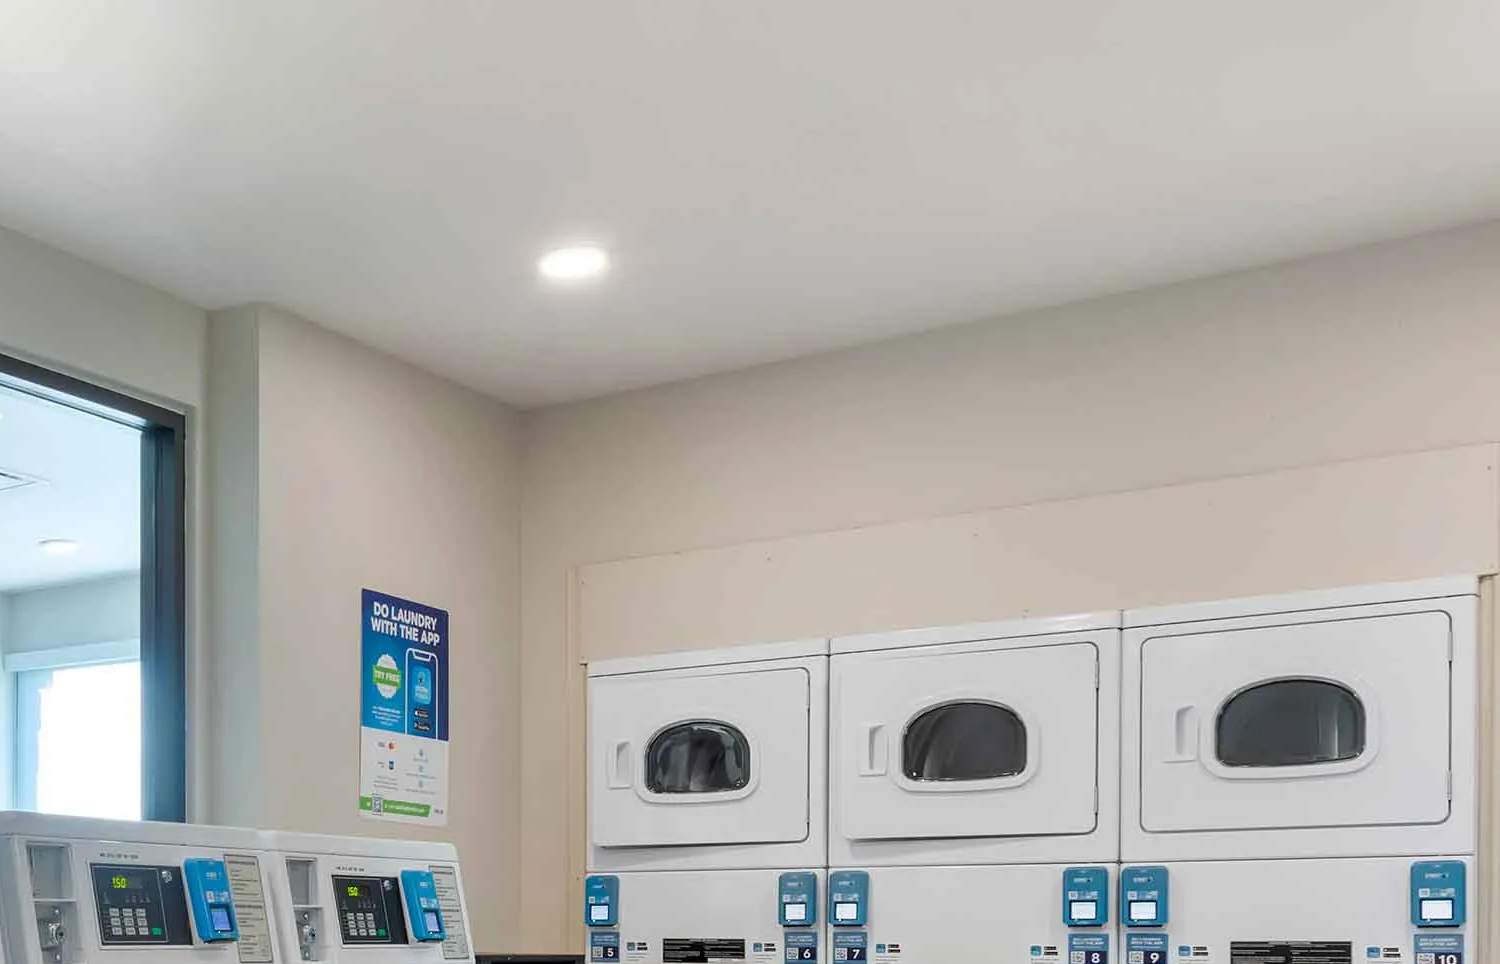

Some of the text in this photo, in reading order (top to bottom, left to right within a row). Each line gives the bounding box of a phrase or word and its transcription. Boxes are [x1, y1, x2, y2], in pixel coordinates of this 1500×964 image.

[373, 601, 437, 631] DO LAUNDRY
[370, 616, 440, 646] WITH THE APP
[607, 947, 614, 957] 5
[803, 948, 811, 959] 6
[852, 949, 860, 959] 7
[1091, 952, 1100, 963] 8
[1150, 952, 1160, 964] 9
